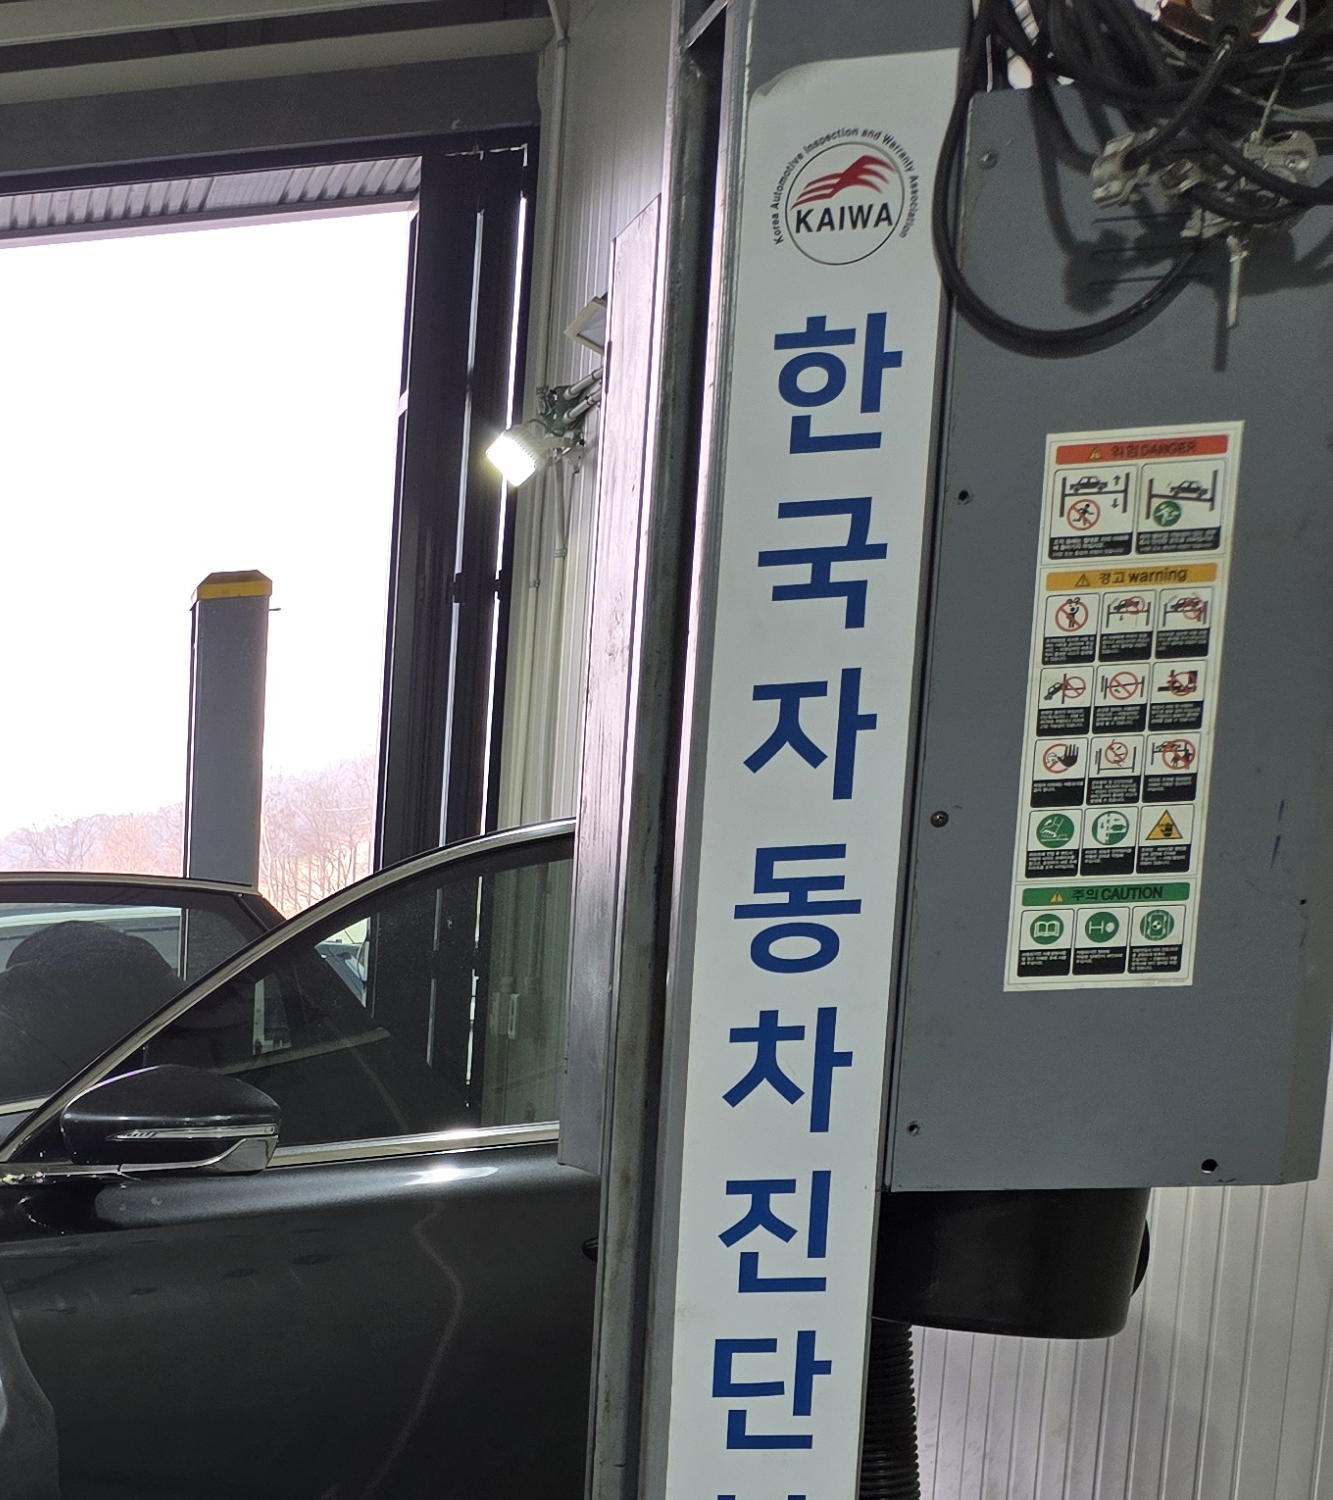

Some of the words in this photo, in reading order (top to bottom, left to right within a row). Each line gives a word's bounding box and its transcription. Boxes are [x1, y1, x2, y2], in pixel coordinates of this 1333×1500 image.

[803, 127, 859, 155] Inspection
[861, 128, 882, 140] and
[882, 133, 915, 173] Warranty
[770, 152, 804, 210] Automotive
[795, 202, 893, 234] KAIWA
[899, 174, 919, 239] Association
[772, 213, 784, 245] Korea
[1128, 567, 1188, 583] warning
[1072, 888, 1098, 901] 주의
[1101, 886, 1163, 901] CAUTION
